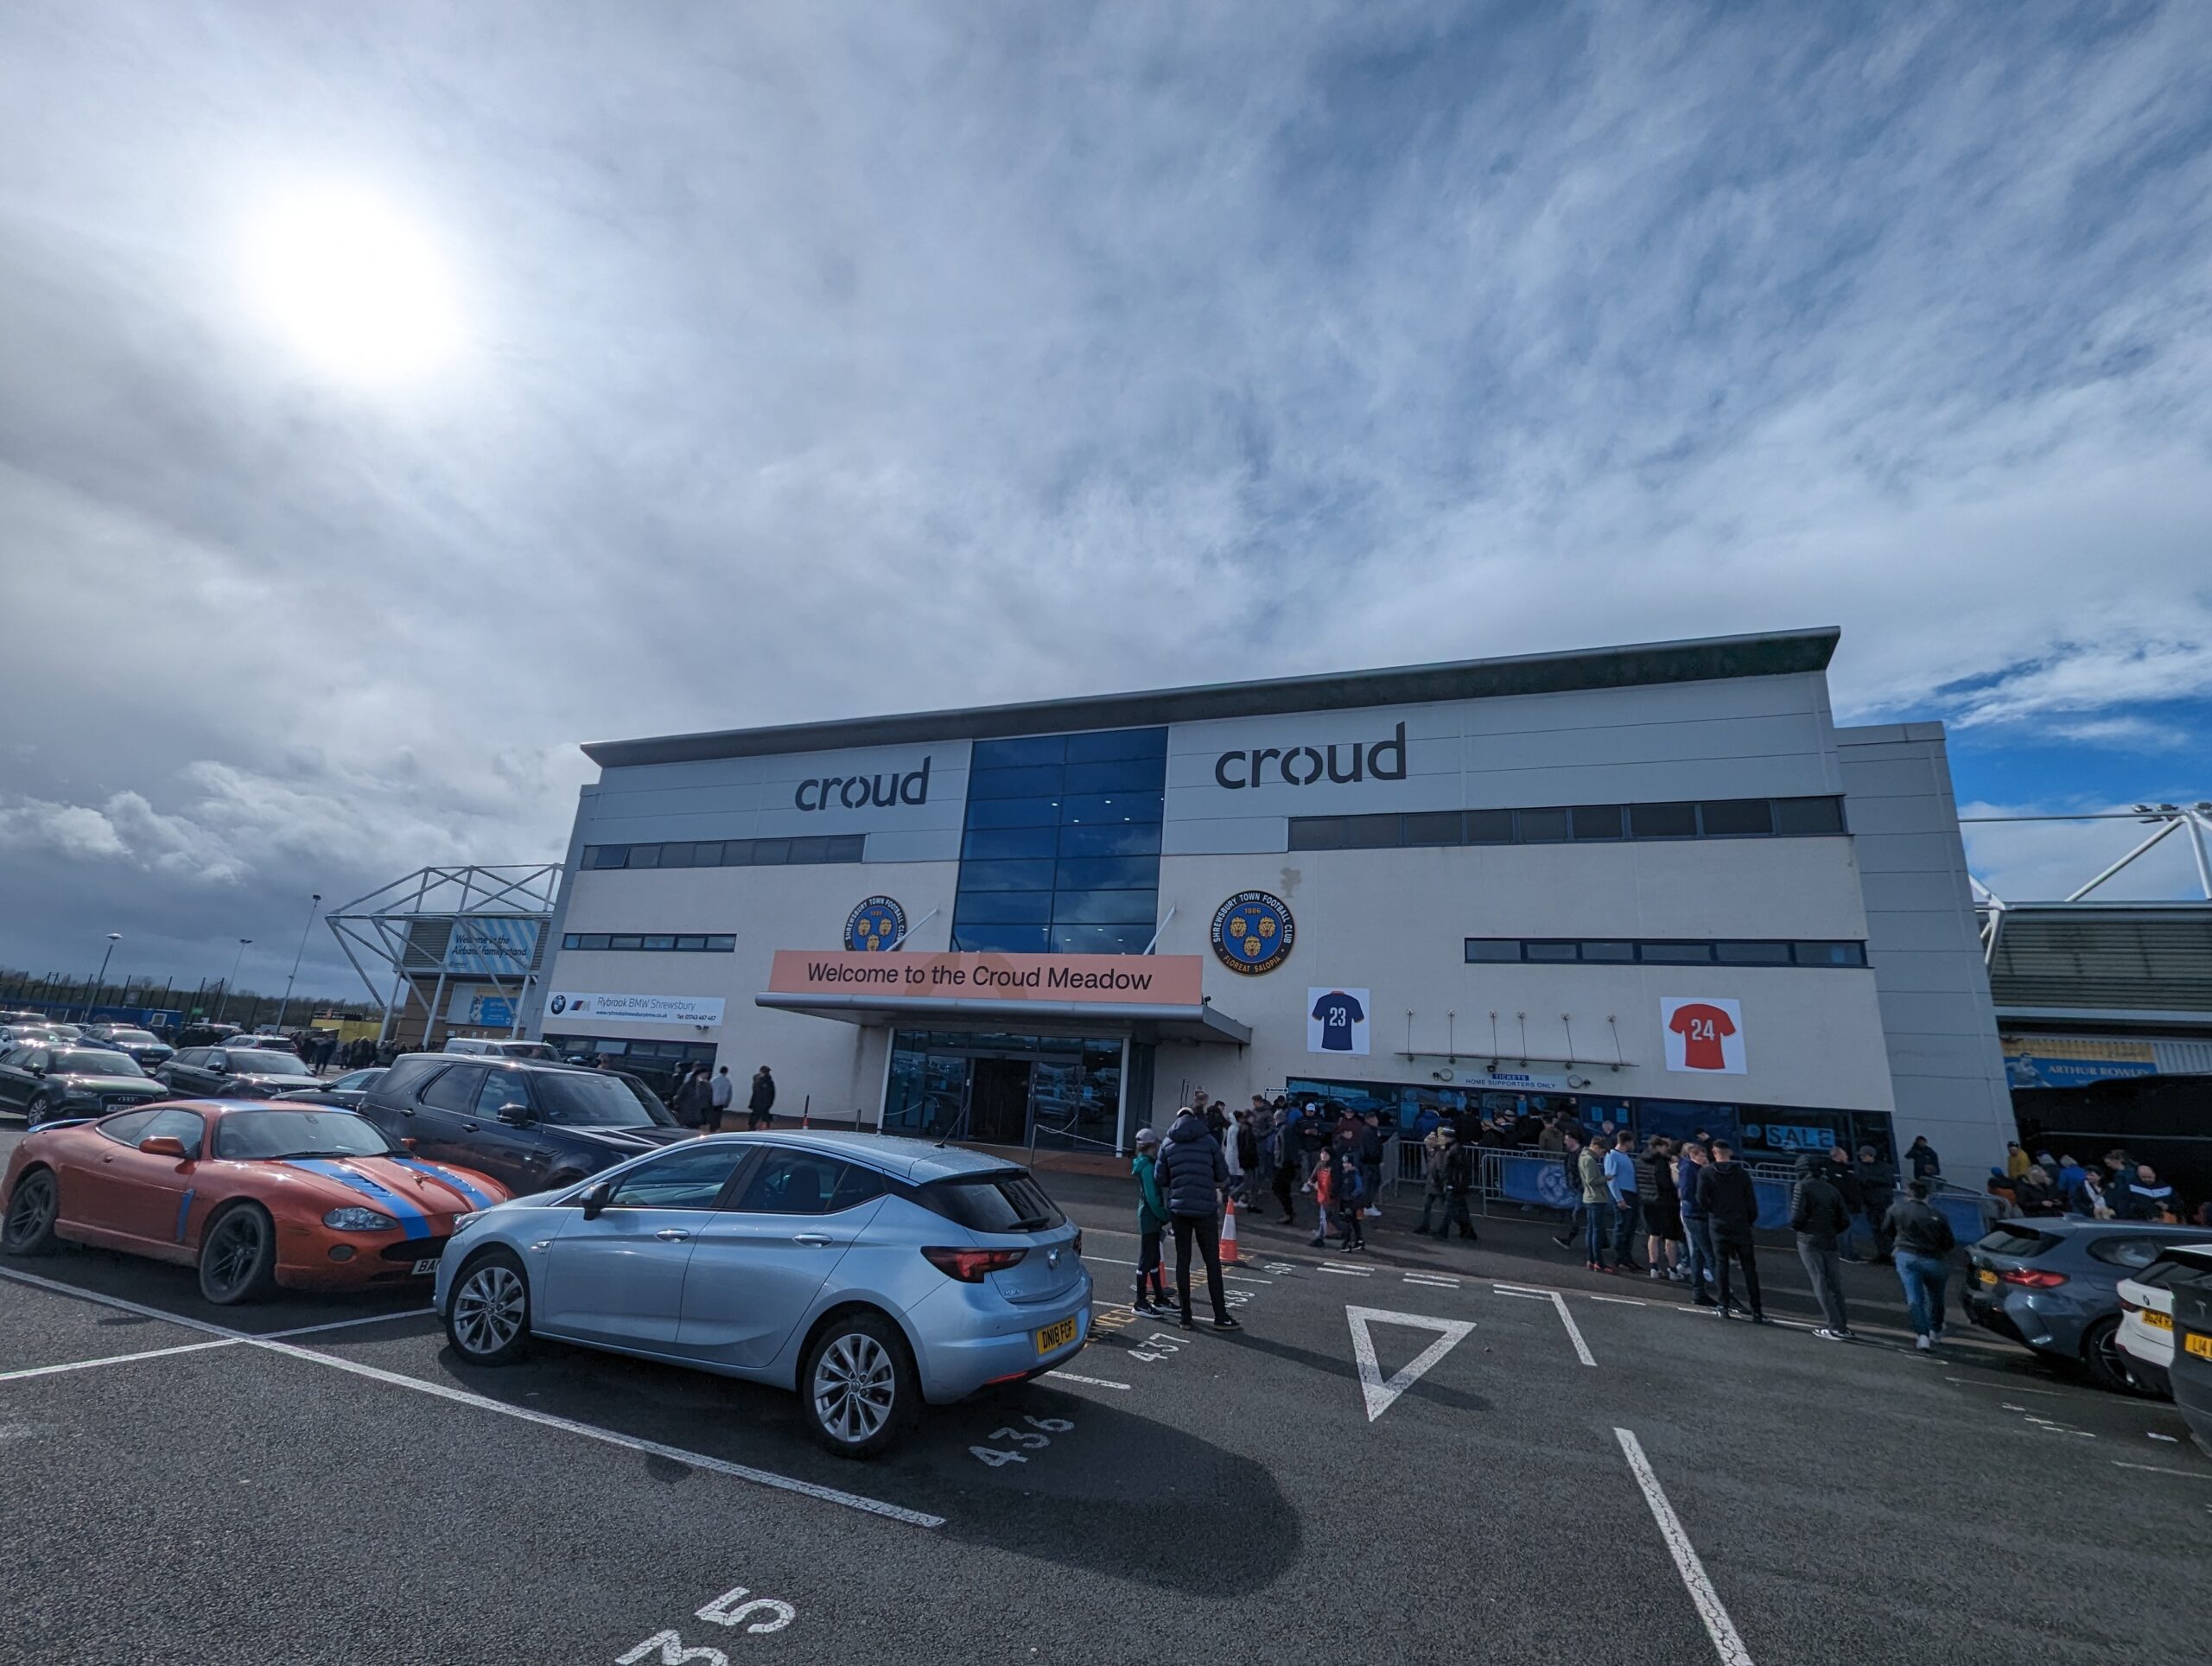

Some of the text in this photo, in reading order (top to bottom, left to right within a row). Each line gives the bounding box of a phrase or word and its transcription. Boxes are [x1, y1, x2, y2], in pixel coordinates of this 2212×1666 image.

[1215, 721, 1407, 789] croud
[795, 755, 930, 811] croud
[885, 900, 904, 924] FOOTBALL
[1212, 892, 1293, 944] SHREWSBURY TOWN FOOTBALL CLUB
[498, 934, 510, 944] the
[1223, 955, 1281, 972] FLOREAT SALOPIA
[807, 962, 1153, 990] Welcome to the Croud Meadow
[597, 997, 696, 1011] Rybrook BMW Shrewsbury
[1328, 1007, 1347, 1028] 23
[1690, 1019, 1716, 1041] 24
[2048, 1065, 2098, 1075] ARTHUR
[1488, 1079, 1535, 1088] SUPPORTERS
[1768, 1127, 1834, 1148] SALE
[1263, 1262, 1297, 1275] 439
[1042, 1326, 1059, 1350] DN18
[1060, 1320, 1073, 1340] FCF
[1127, 1332, 1191, 1362] 437
[968, 1415, 1075, 1467] 436
